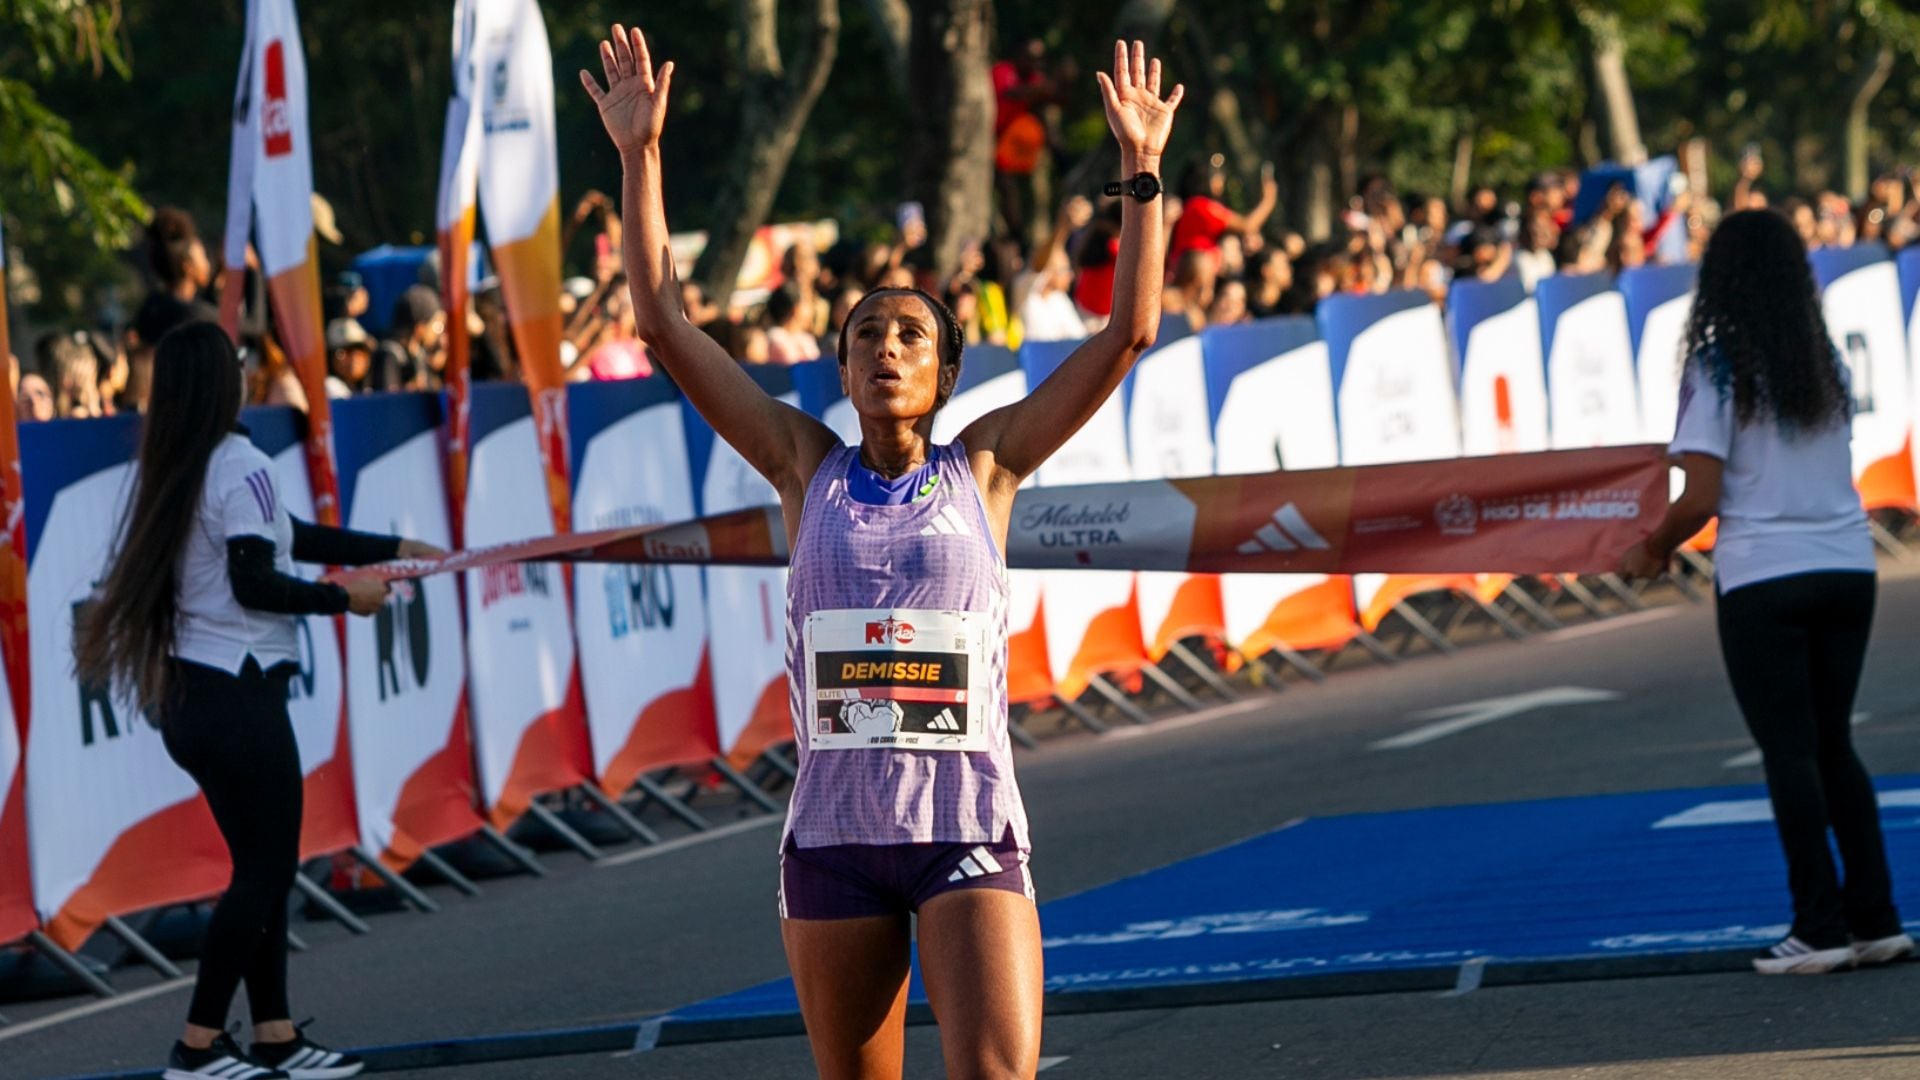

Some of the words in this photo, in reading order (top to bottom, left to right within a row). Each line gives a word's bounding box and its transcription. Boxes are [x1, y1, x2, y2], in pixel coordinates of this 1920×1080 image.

[1020, 502, 1130, 531] Michelob
[1482, 505, 1520, 521] RIO
[1523, 502, 1550, 519] DE
[1554, 500, 1640, 520] JANEIRO
[1039, 529, 1122, 547] ULTRA
[841, 661, 942, 681] DEMISSIE
[819, 689, 841, 699] ELITE
[955, 690, 966, 703] 6
